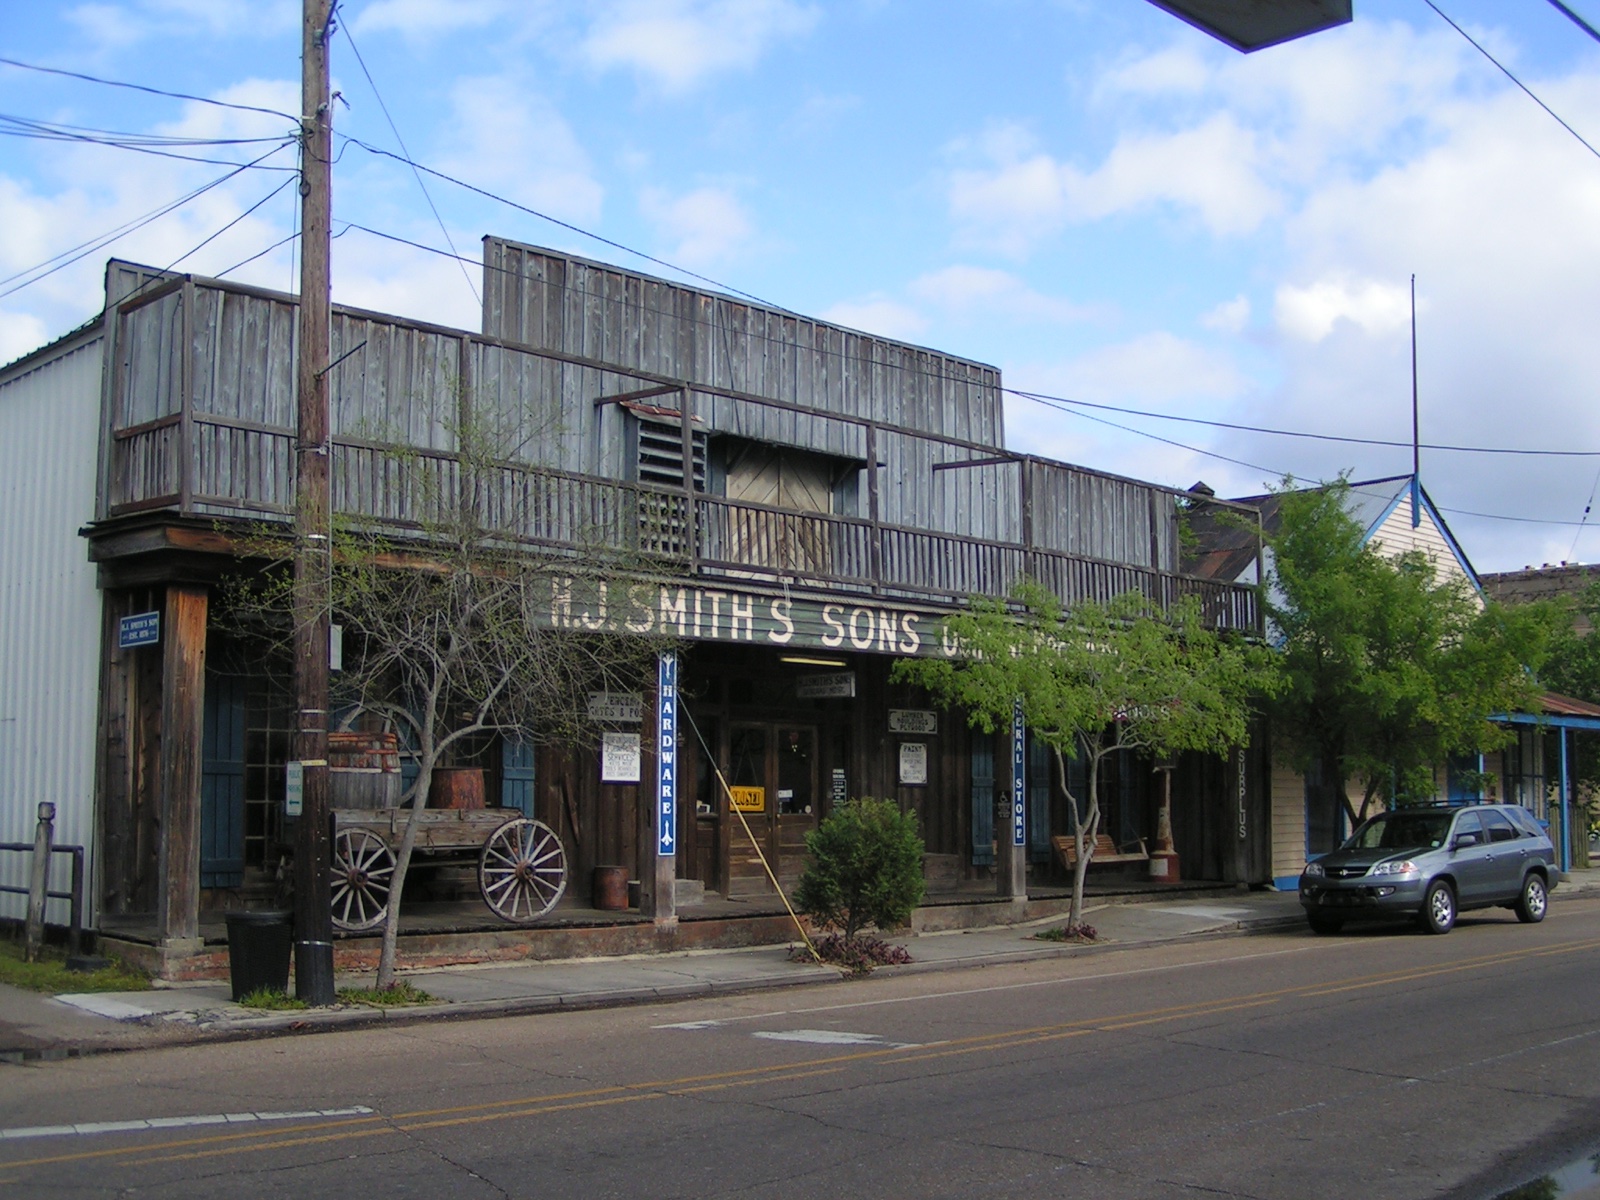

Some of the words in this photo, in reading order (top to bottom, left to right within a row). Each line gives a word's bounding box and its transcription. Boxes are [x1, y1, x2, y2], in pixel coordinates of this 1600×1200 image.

[626, 584, 795, 644] SMITH'S
[820, 602, 921, 655] SONS
[662, 685, 673, 814] HARDWARE
[903, 744, 922, 753] PAINT
[1015, 778, 1023, 839] STORE
[1238, 750, 1247, 839] SURPLUS
